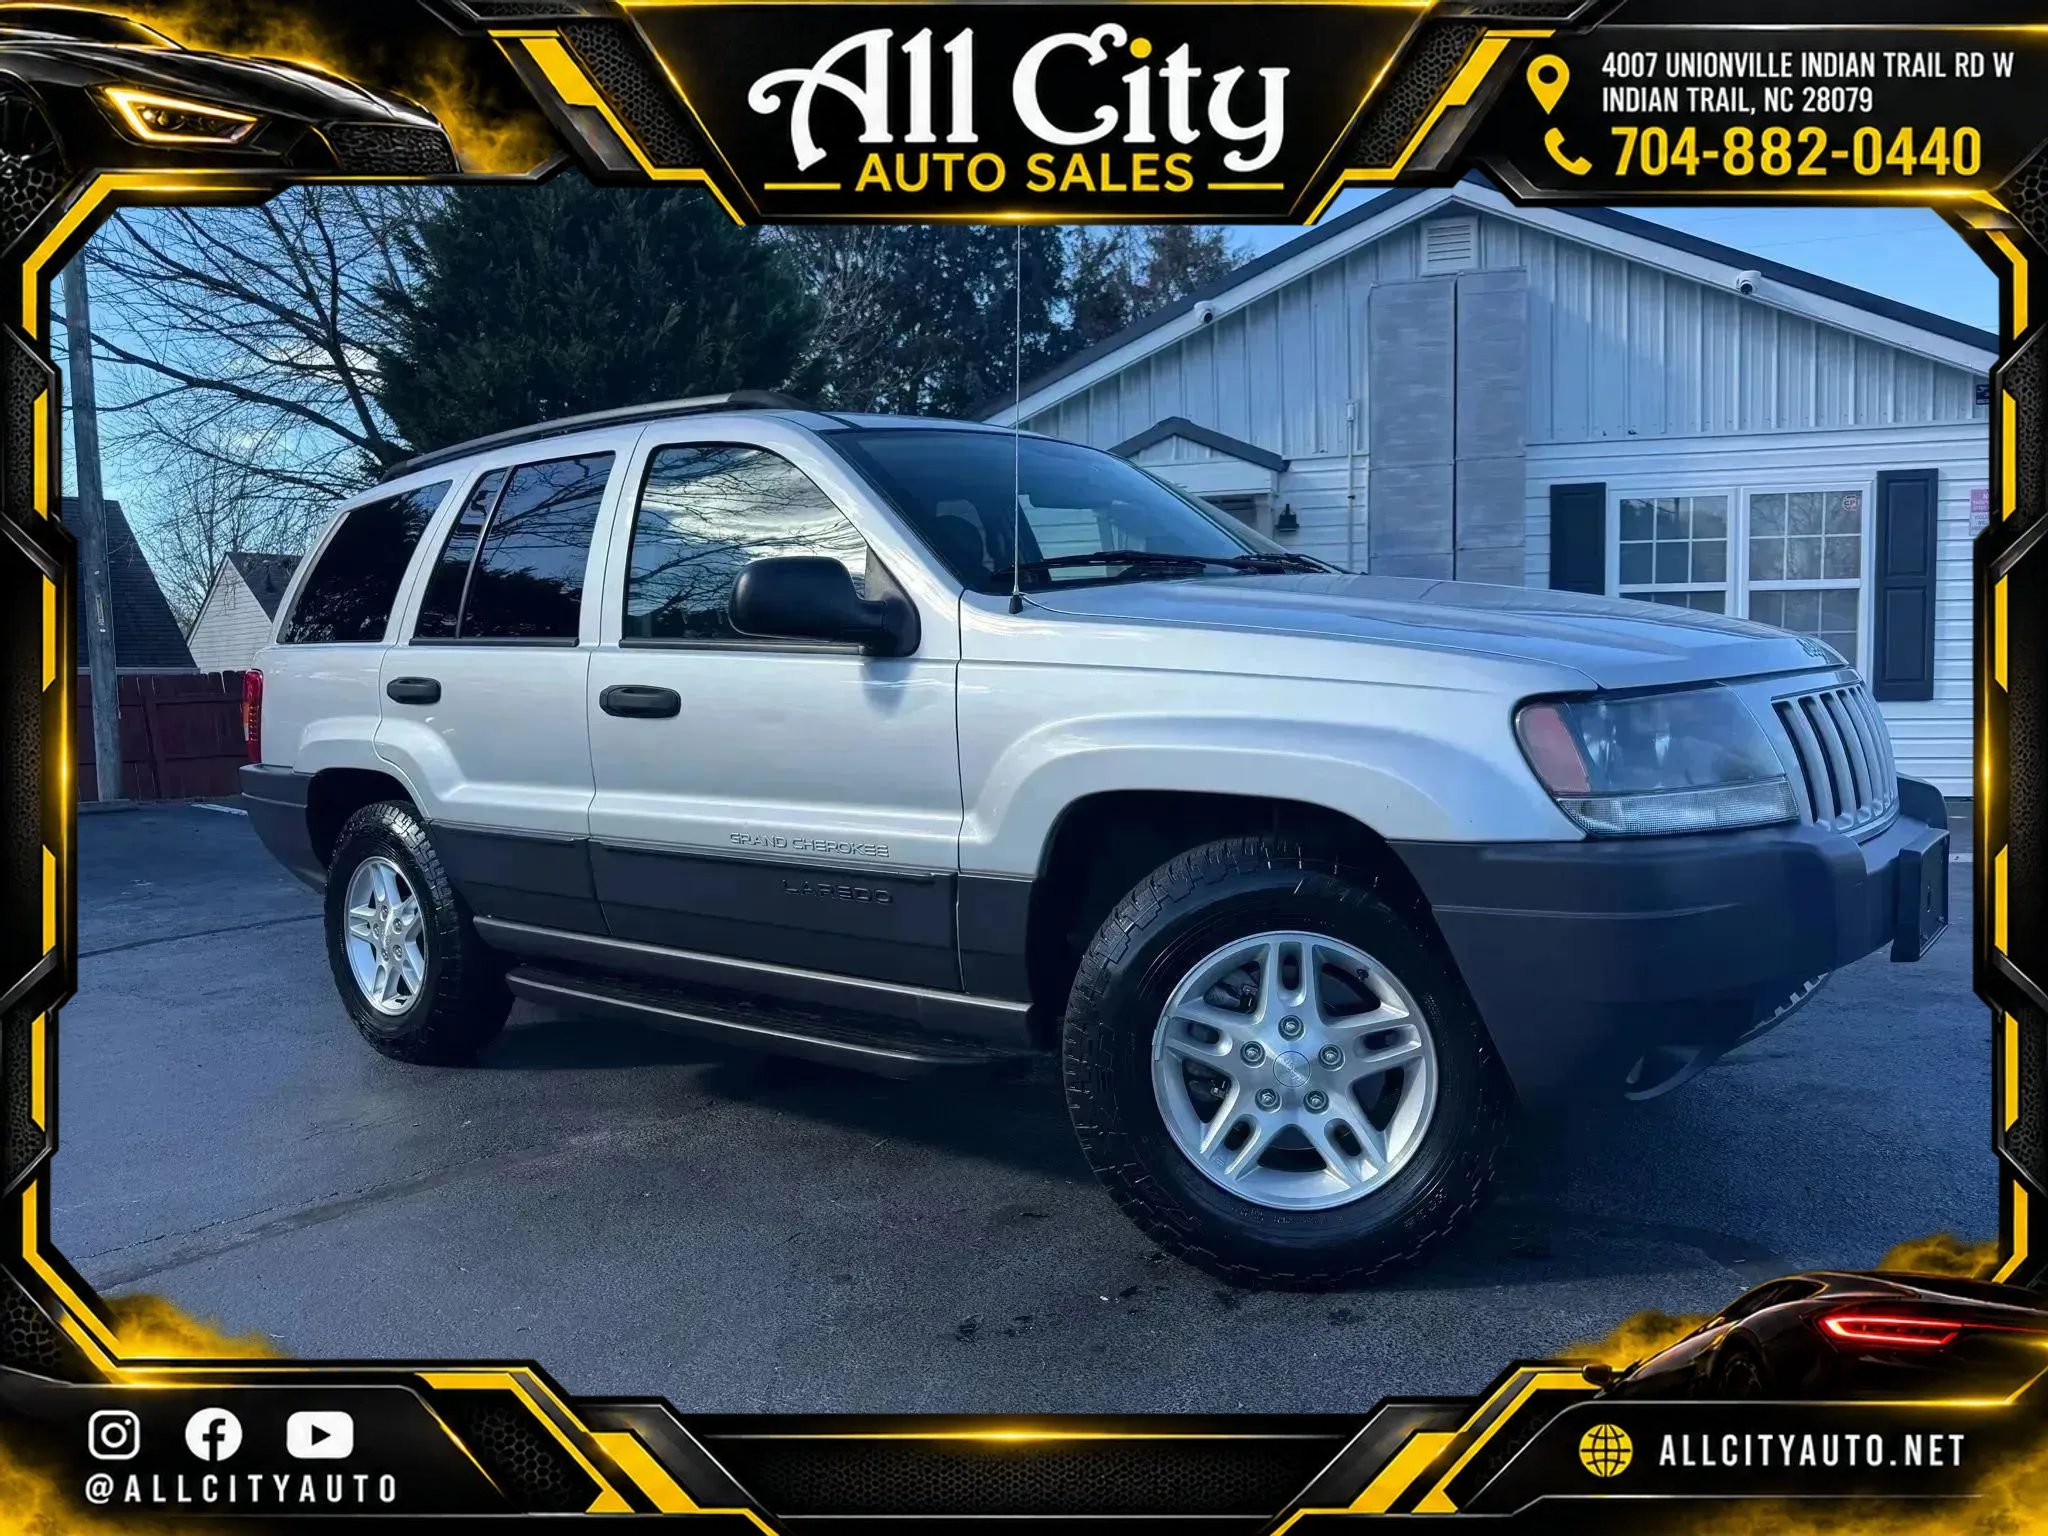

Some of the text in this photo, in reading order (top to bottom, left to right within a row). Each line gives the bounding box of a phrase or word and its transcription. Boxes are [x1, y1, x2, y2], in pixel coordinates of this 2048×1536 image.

[730, 832, 889, 858] GRAND CHEROKEE
[781, 879, 893, 905] LAREDO
